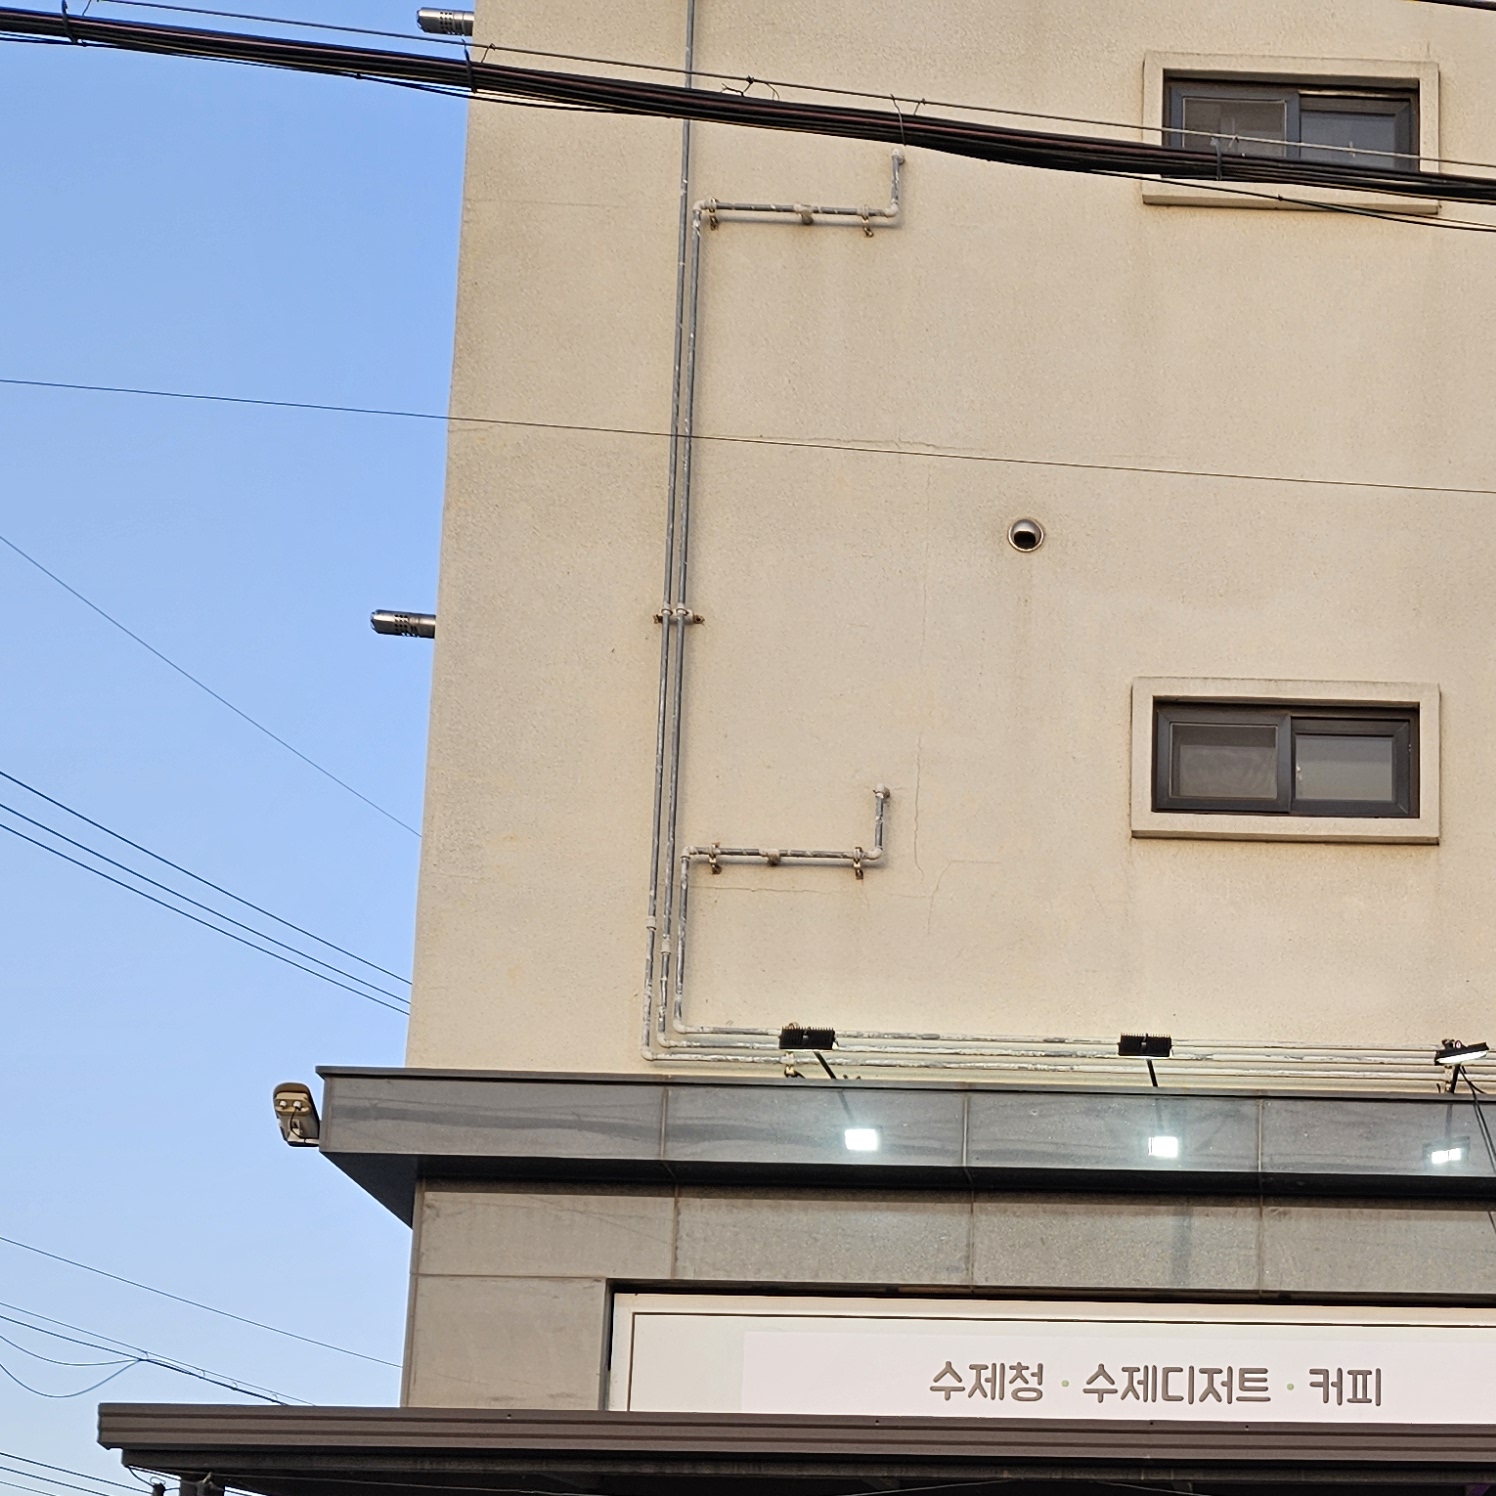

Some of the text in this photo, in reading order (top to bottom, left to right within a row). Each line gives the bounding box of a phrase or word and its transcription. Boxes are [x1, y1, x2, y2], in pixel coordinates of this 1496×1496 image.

[930, 1361, 1381, 1406] 수제청 수제디저트 커피
